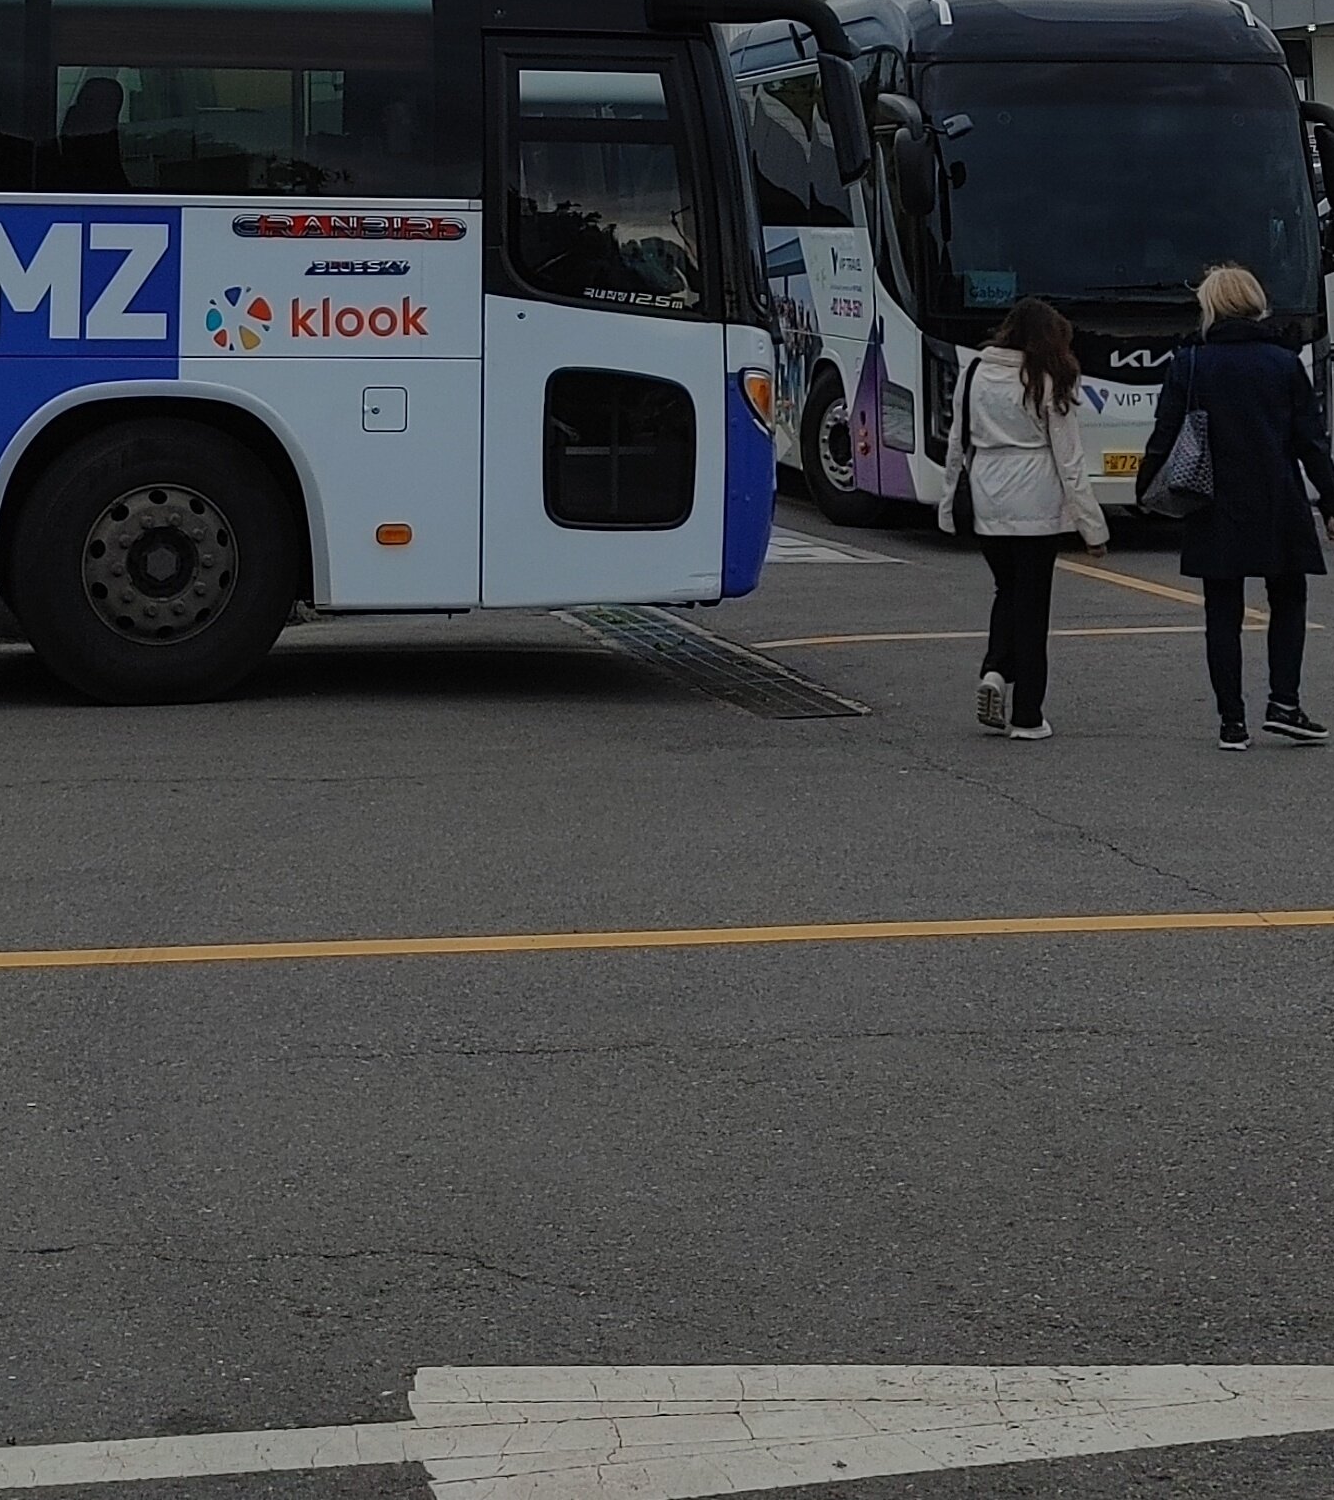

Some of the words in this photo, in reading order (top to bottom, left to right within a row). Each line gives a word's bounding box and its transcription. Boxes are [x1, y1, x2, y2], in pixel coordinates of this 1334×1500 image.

[232, 214, 467, 240] GRANBIRD
[291, 296, 429, 338] klook
[1115, 393, 1142, 407] VIP
